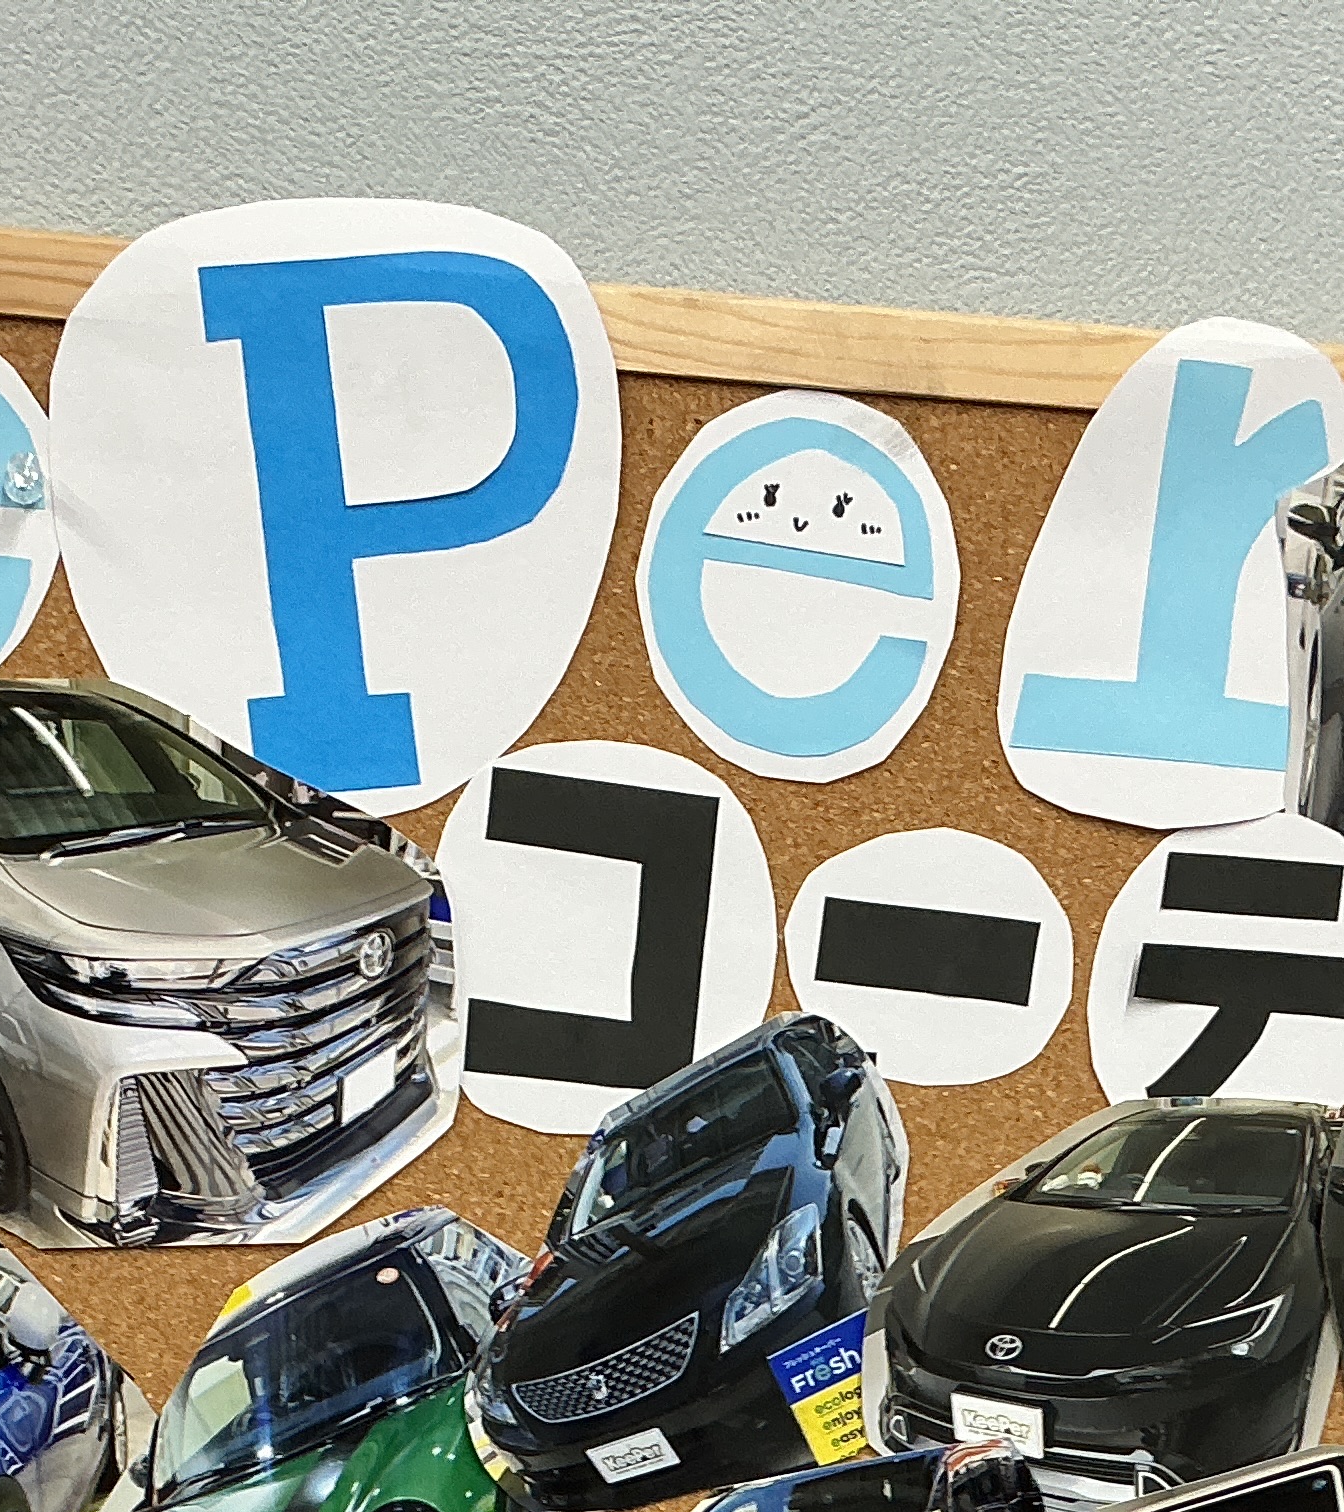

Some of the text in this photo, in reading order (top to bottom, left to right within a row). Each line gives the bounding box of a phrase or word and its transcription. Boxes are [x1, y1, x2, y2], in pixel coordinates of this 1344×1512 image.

[790, 1347, 862, 1394] Fresh
[962, 1408, 1030, 1440] KeePer
[602, 1444, 662, 1471] KeePer
